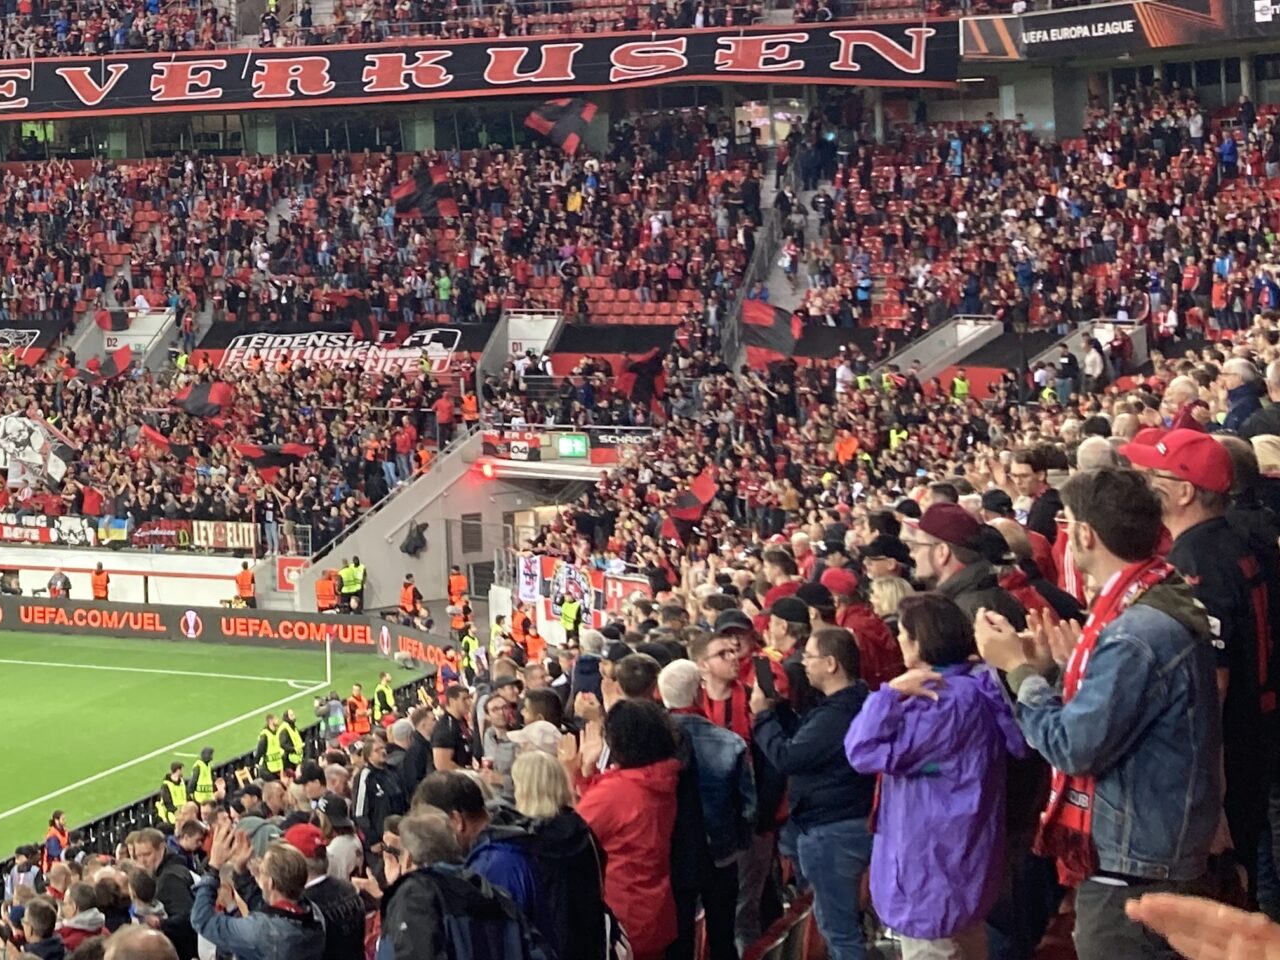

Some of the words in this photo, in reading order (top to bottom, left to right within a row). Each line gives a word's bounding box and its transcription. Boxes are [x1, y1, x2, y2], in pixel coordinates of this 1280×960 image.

[1021, 29, 1049, 43] UEFA
[1050, 24, 1091, 41] EUROPA
[1092, 20, 1134, 36] LEAGUE
[106, 337, 118, 348] D2
[511, 444, 528, 455] 04
[193, 520, 214, 546] LEV
[19, 605, 167, 631] UEFA.COM/UEL
